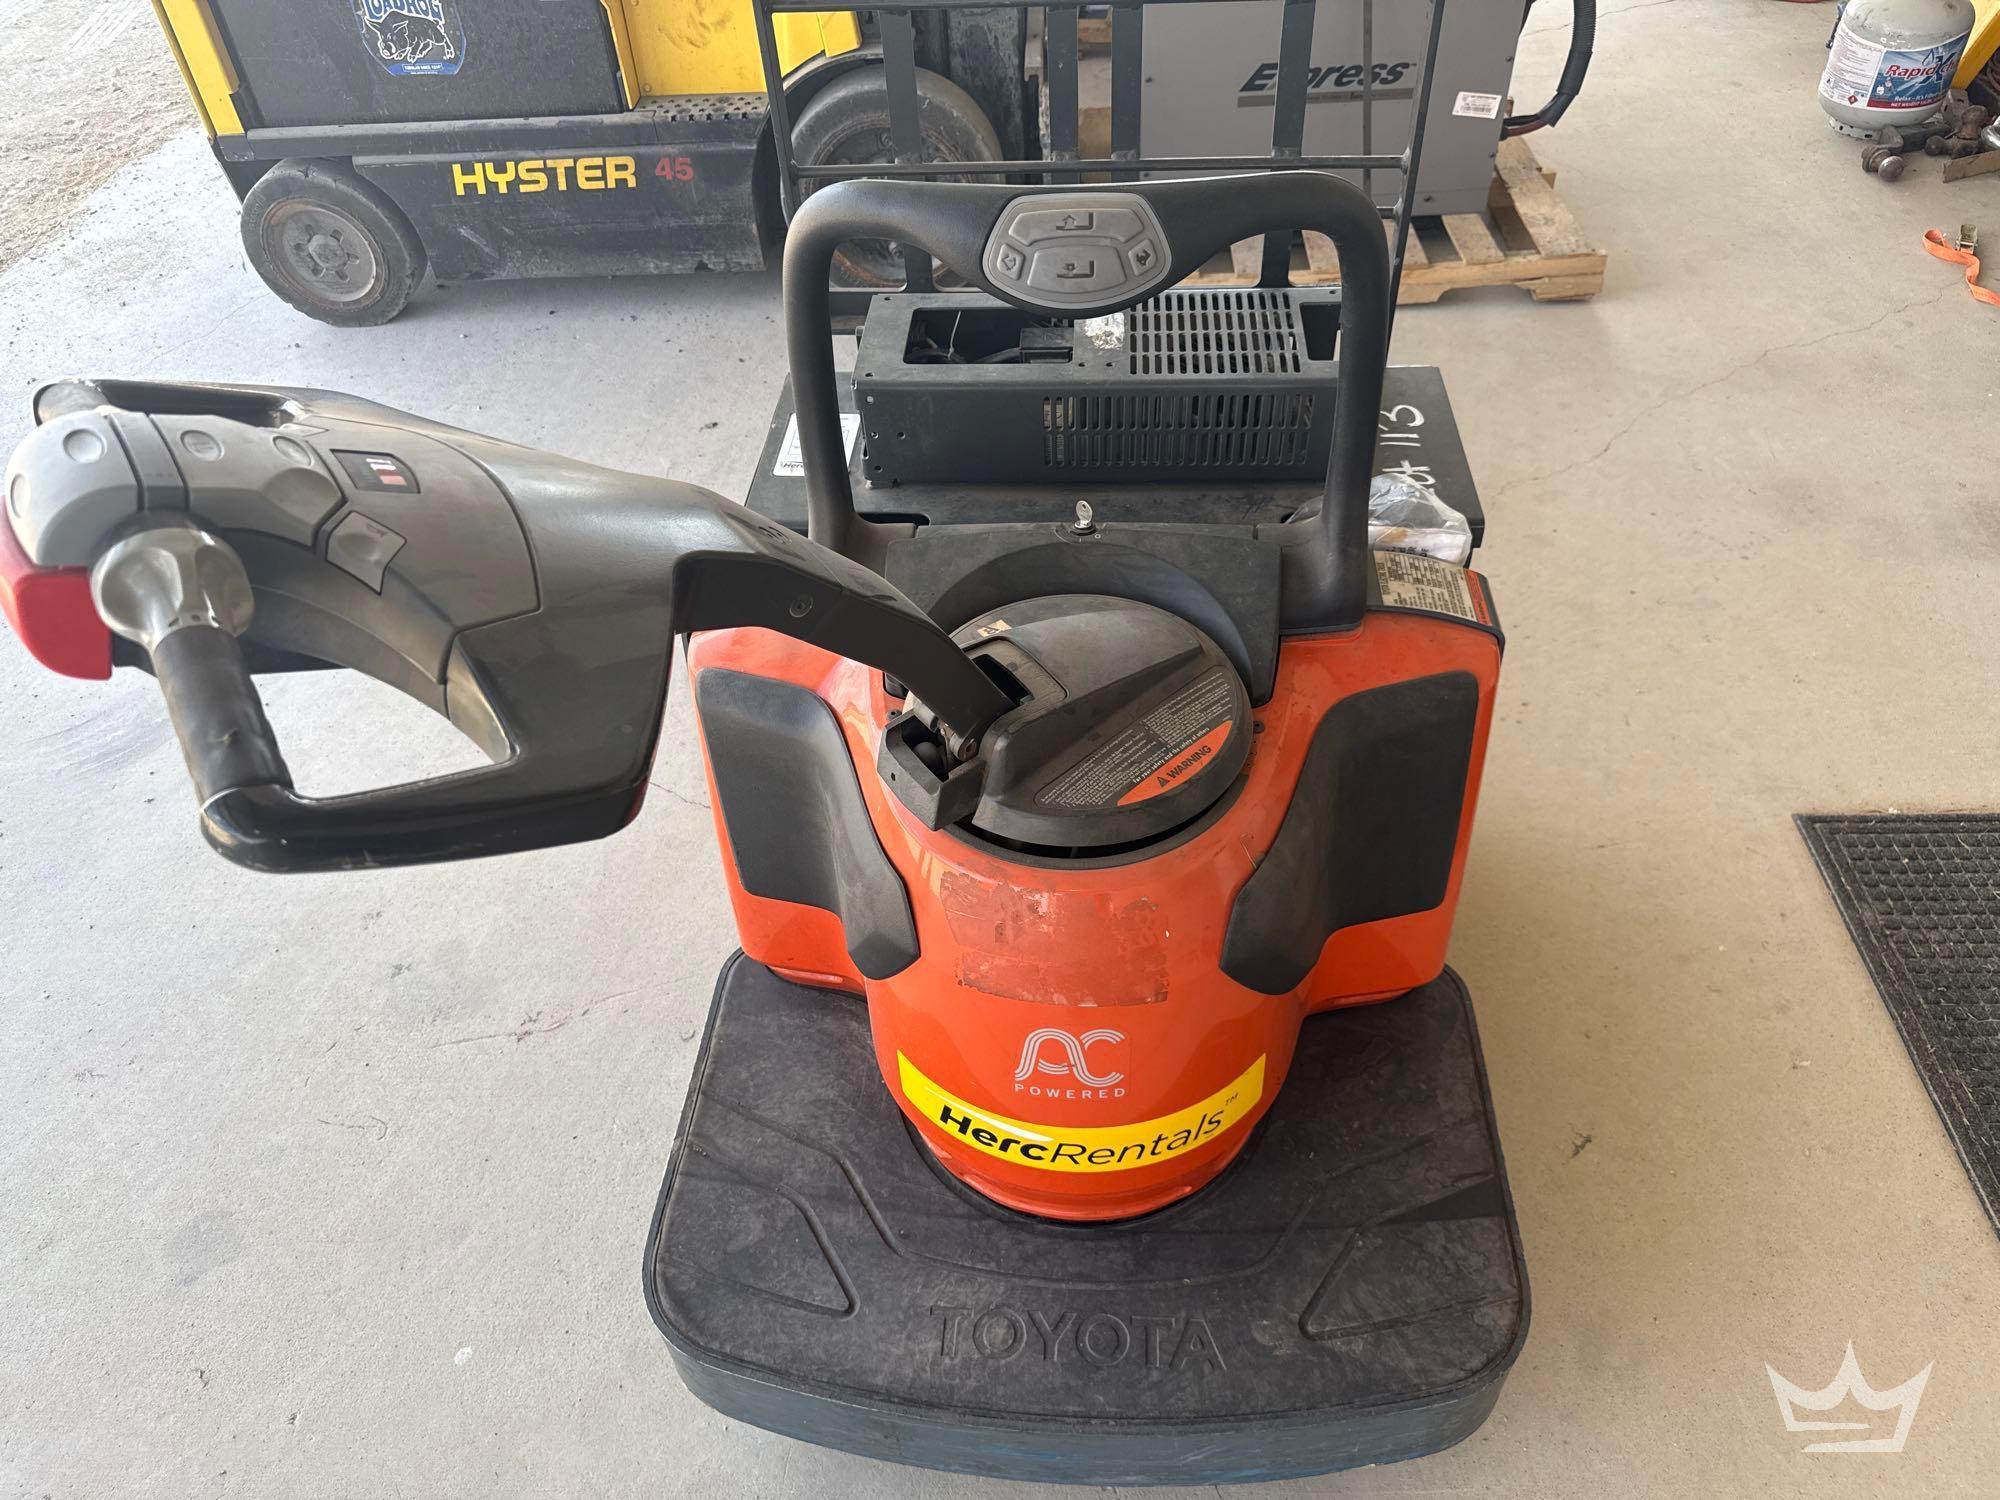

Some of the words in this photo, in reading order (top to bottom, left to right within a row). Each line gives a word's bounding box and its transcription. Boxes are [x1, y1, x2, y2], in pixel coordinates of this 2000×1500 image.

[452, 155, 637, 196] HYSTER
[655, 157, 694, 181] 45
[1166, 745, 1212, 779] WARNING
[1014, 1028, 1125, 1087] AC
[1014, 1083, 1125, 1099] POWERED
[930, 1302, 1227, 1371] TOYOTA
